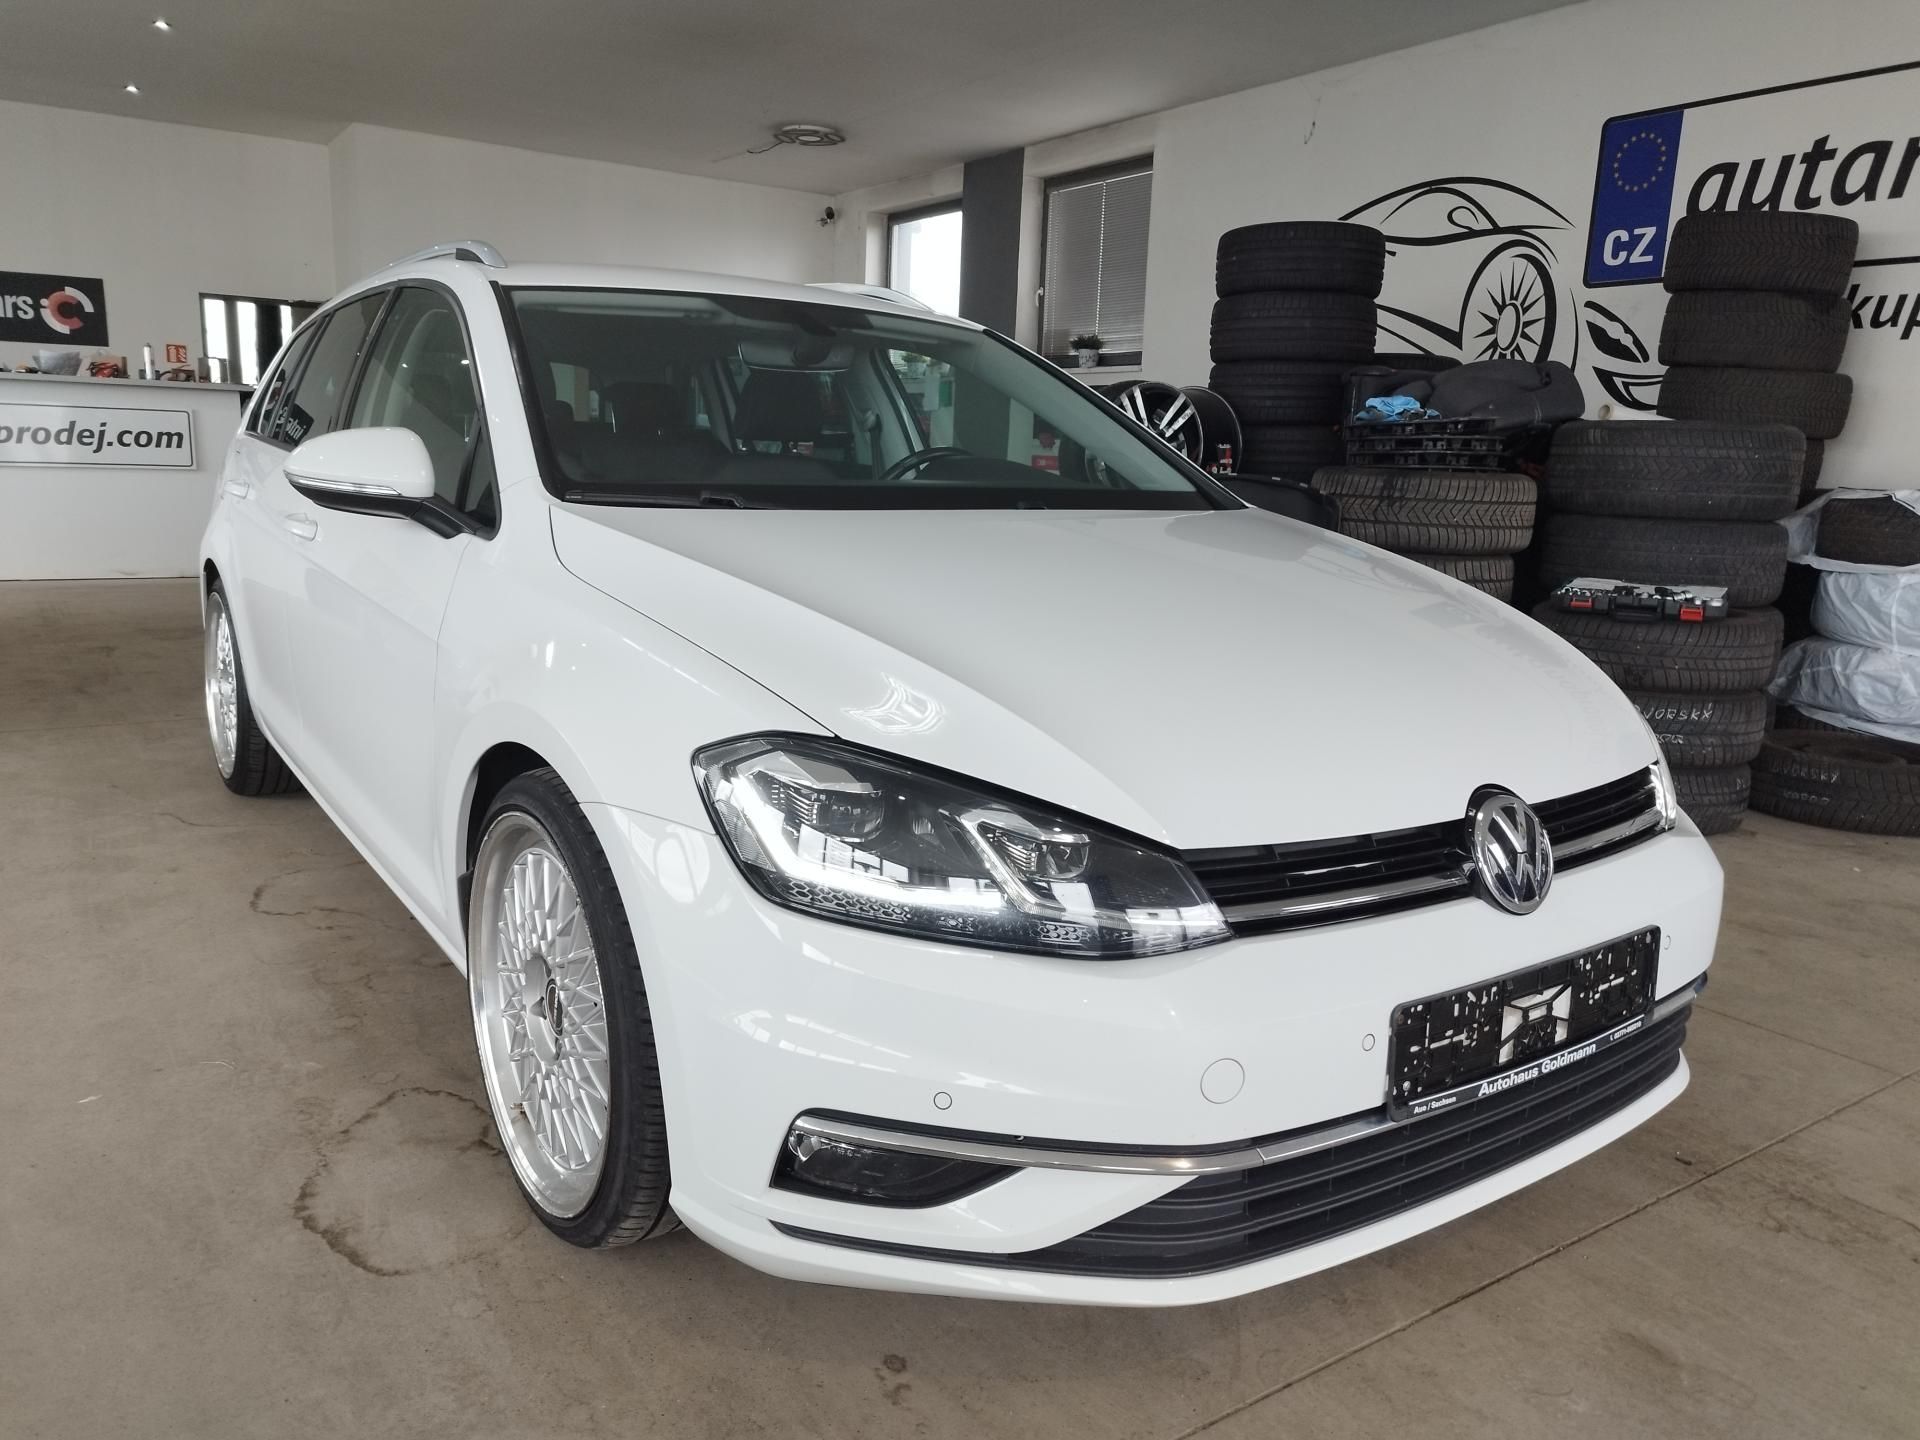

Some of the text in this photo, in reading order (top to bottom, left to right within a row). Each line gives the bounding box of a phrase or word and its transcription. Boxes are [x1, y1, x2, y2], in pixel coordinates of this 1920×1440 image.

[1603, 226, 1658, 266] CZ
[1478, 1043, 1596, 1097] Autohaus Goldmann
